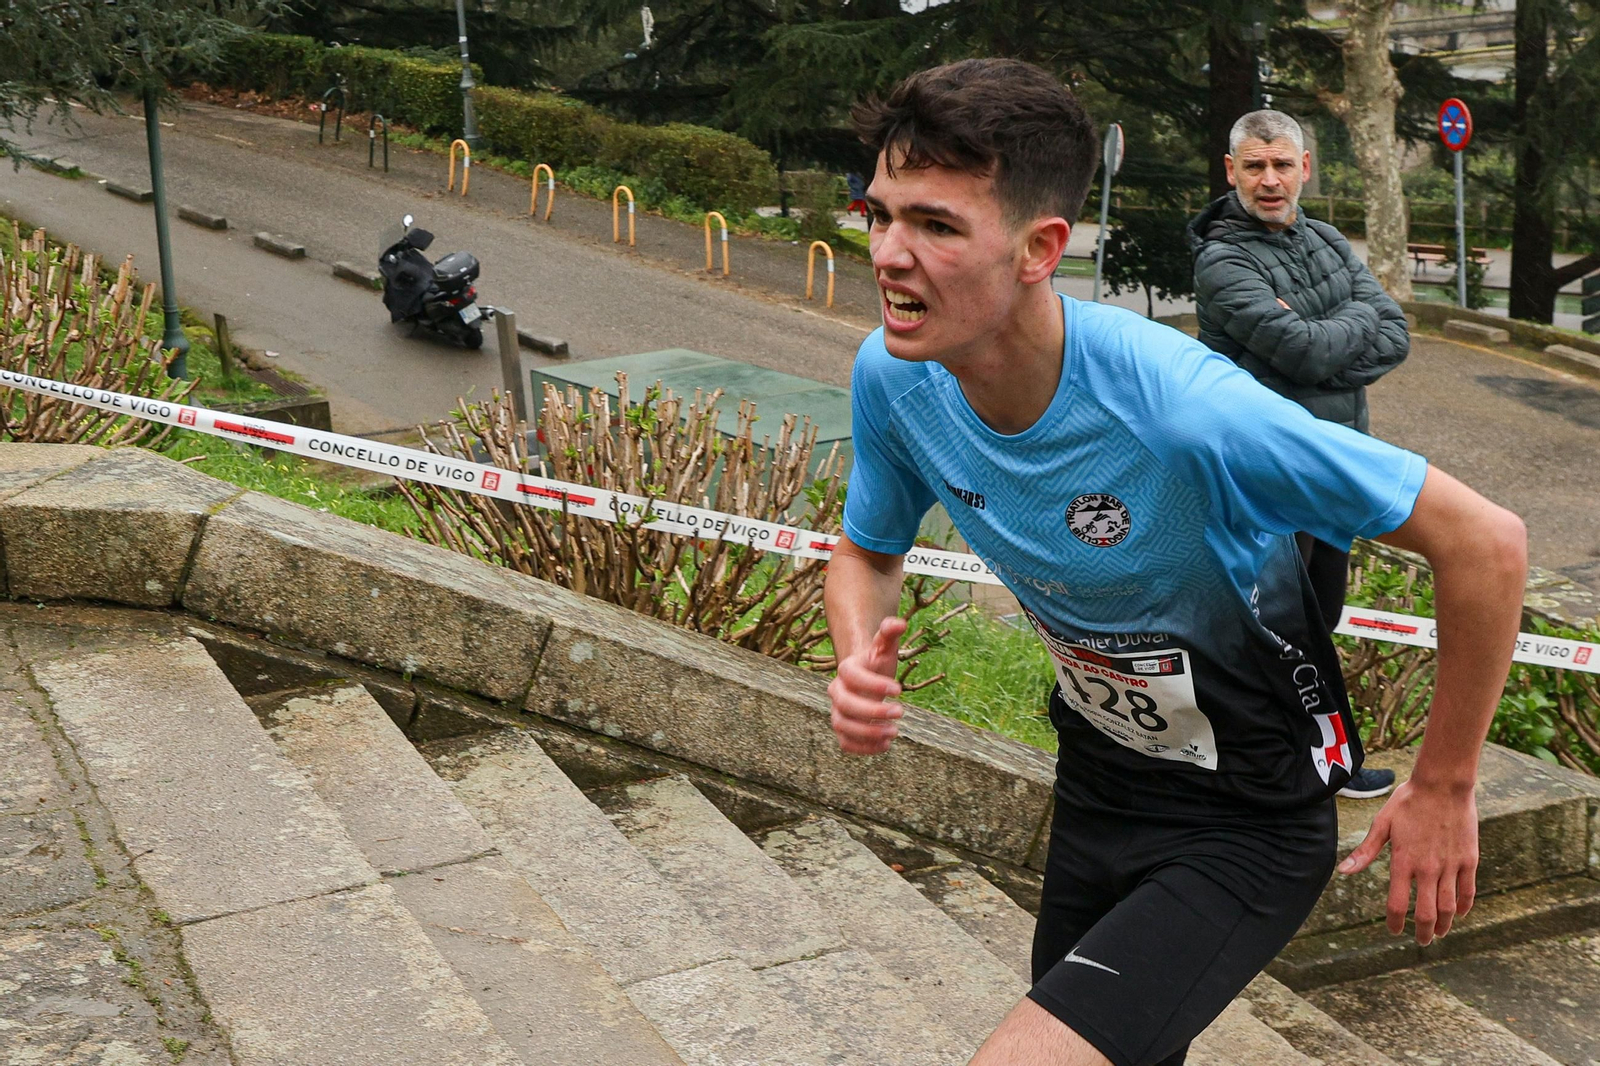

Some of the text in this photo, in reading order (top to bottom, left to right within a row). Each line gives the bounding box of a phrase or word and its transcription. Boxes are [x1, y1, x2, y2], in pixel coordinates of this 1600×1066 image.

[1, 372, 171, 418] CONCELLO DE VIGO
[308, 438, 475, 483] CONCELLO DE VIGO
[608, 500, 771, 541] COELLO DE VIGO
[1066, 495, 1130, 545] CLUB TRIATLON MAR DE VIGO
[905, 553, 982, 573] ONCELLO
[1535, 643, 1571, 658] VIGO
[1083, 664, 1100, 674] AO
[1100, 668, 1149, 689] CASTRO
